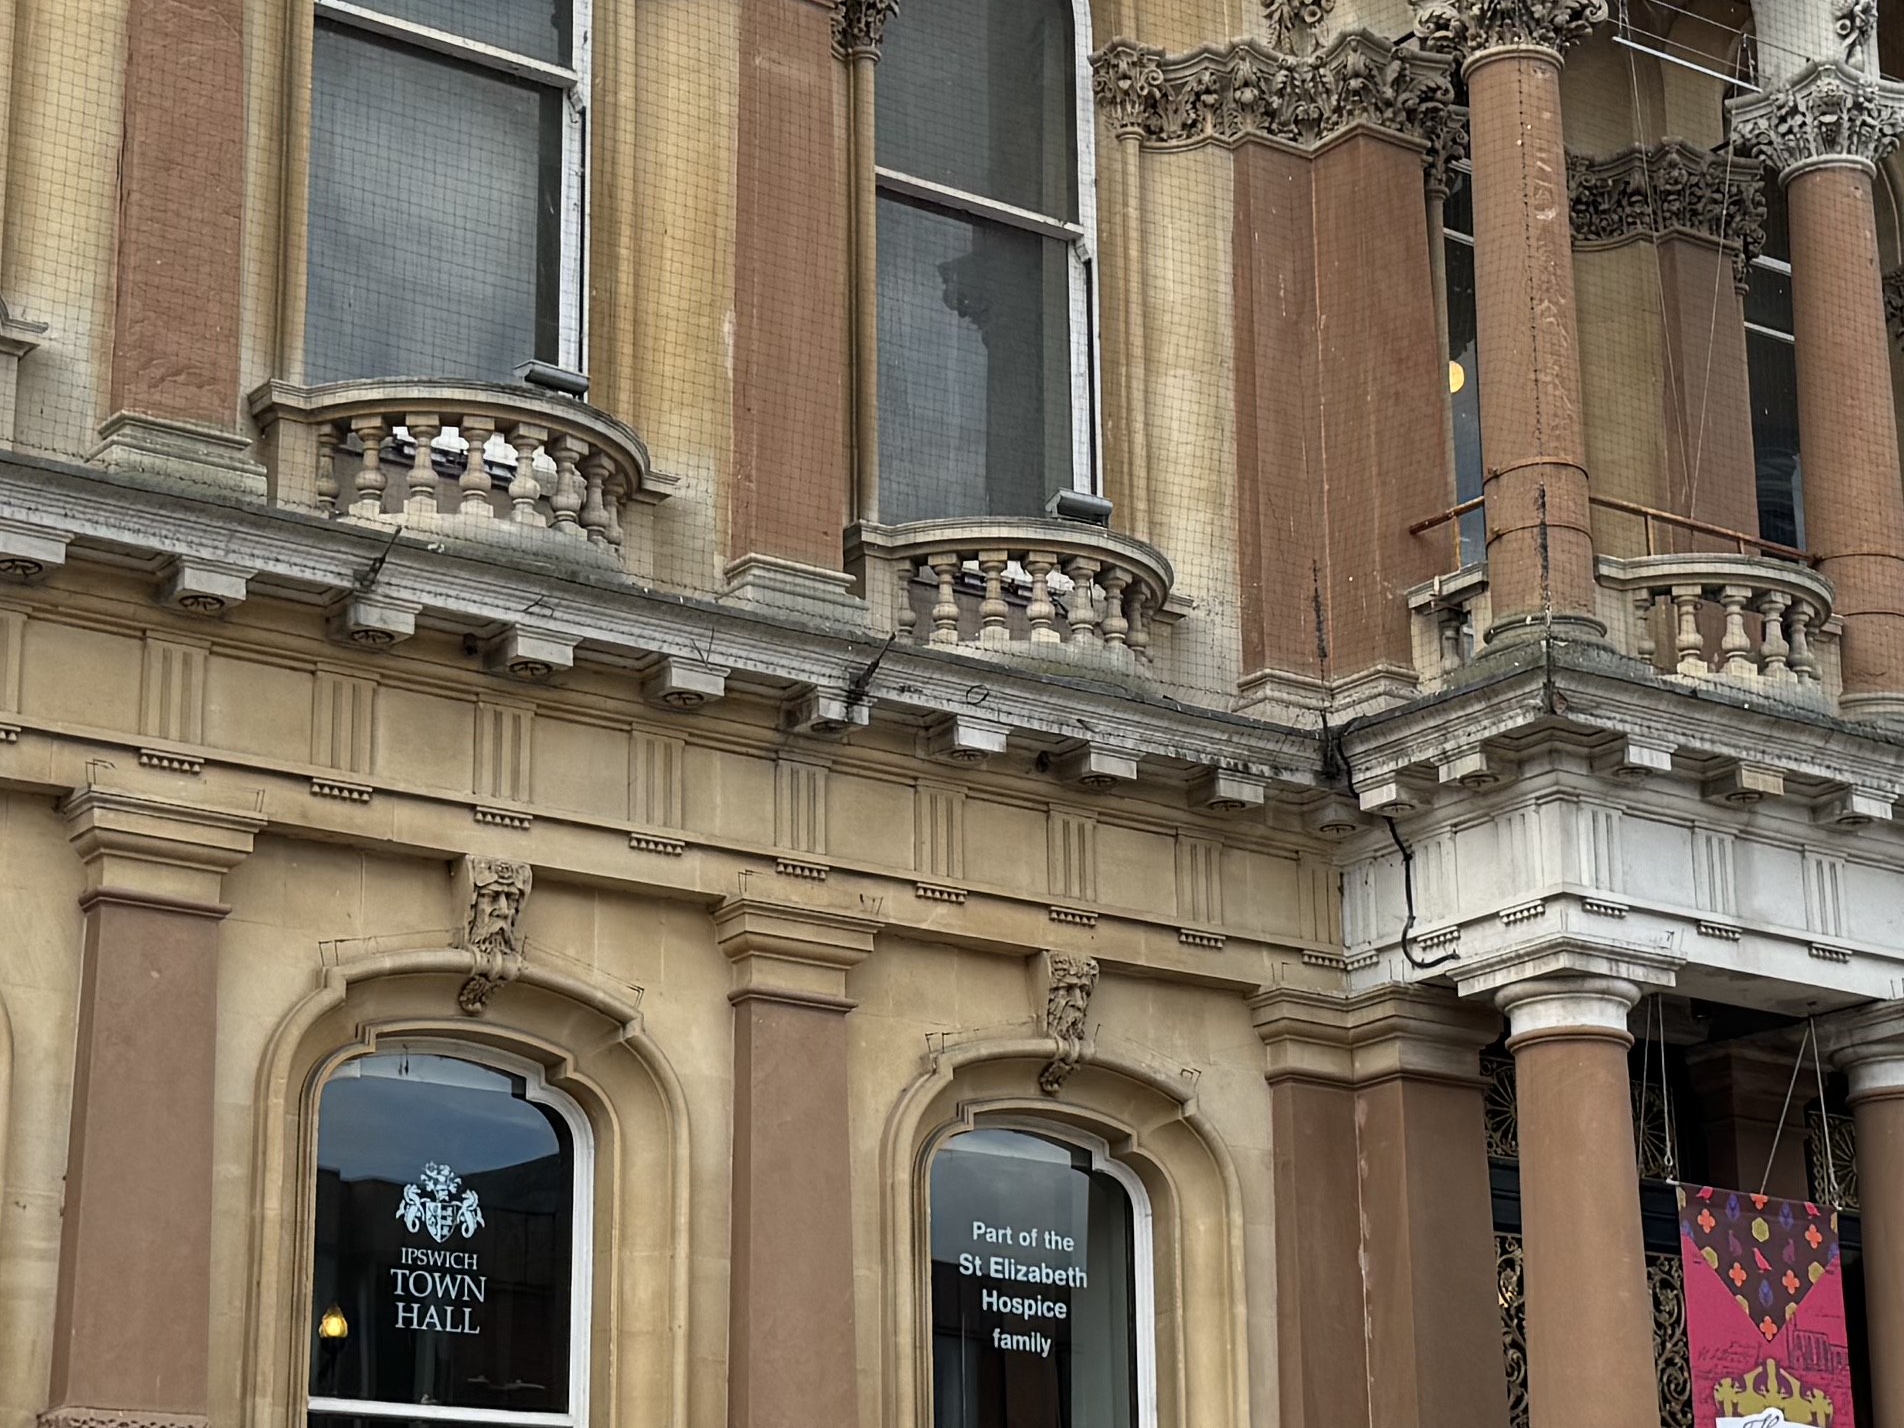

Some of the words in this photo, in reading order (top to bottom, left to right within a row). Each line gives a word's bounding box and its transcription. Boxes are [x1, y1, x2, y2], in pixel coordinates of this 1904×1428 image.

[972, 1220, 1013, 1245] Part
[1018, 1228, 1038, 1247] of
[1044, 1230, 1075, 1252] the
[401, 1247, 478, 1270] IPSWICH
[959, 1252, 982, 1277] St
[989, 1256, 1088, 1289] Elizabeth
[390, 1268, 487, 1303] TOWN
[395, 1301, 480, 1334] HALL
[982, 1288, 1068, 1321] Hospice
[992, 1327, 1052, 1358] family
